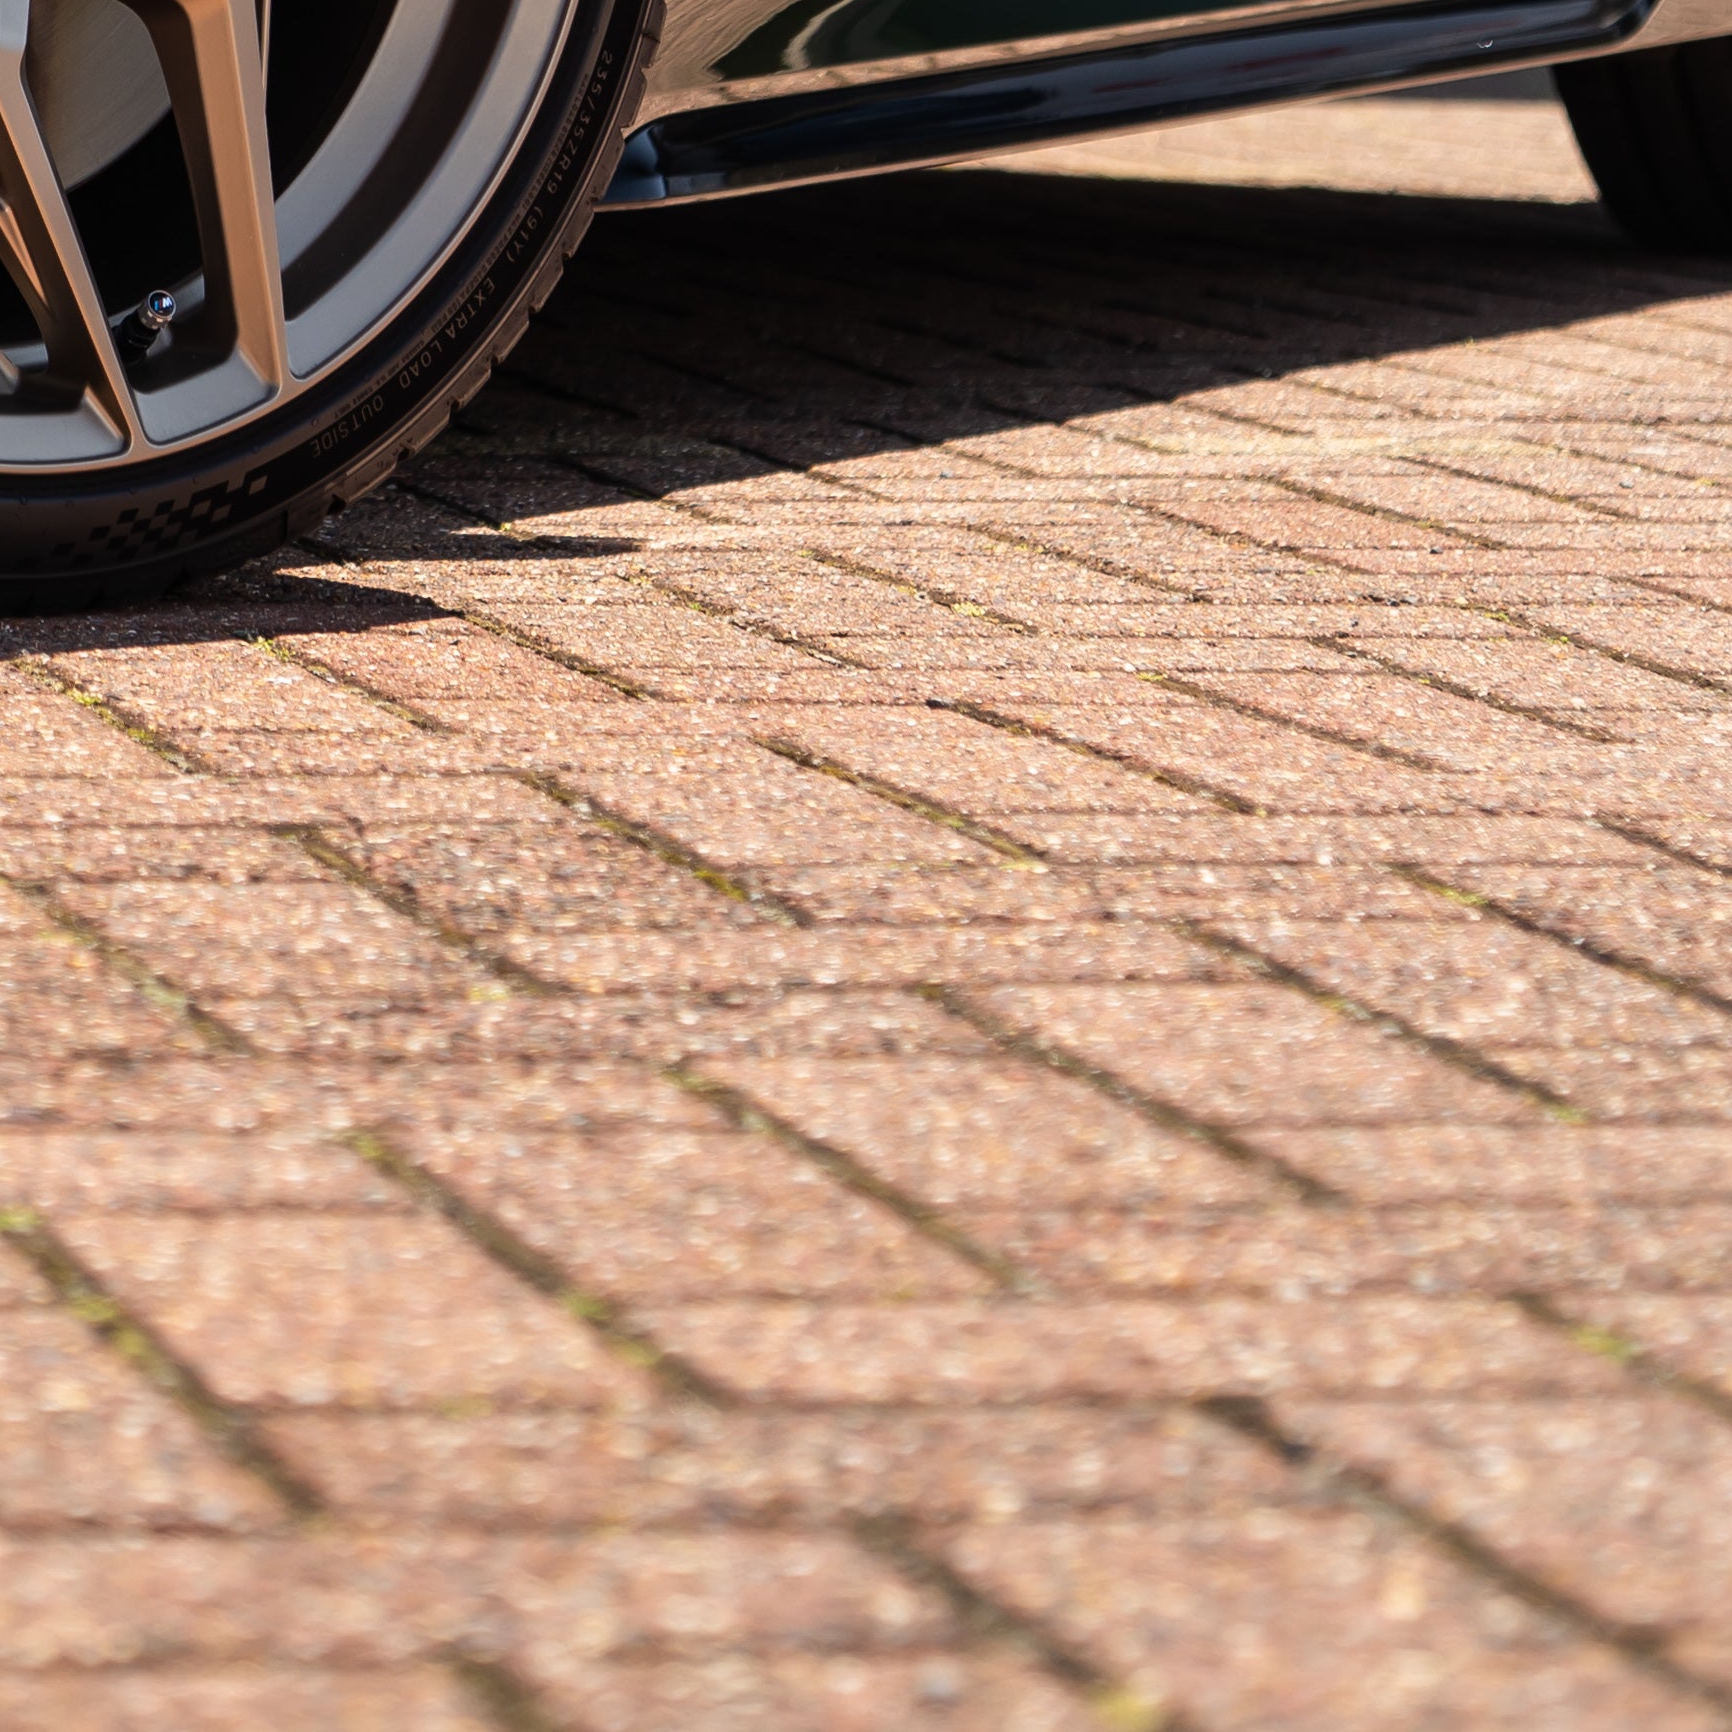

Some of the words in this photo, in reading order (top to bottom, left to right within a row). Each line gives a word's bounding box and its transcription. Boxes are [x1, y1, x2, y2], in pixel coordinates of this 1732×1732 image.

[545, 49, 613, 195] 235/35ZR19
[508, 204, 544, 266] (91Y)
[445, 277, 497, 339] EXTRA
[397, 337, 445, 389] LOAD
[312, 395, 386, 457] OUTSIDE
